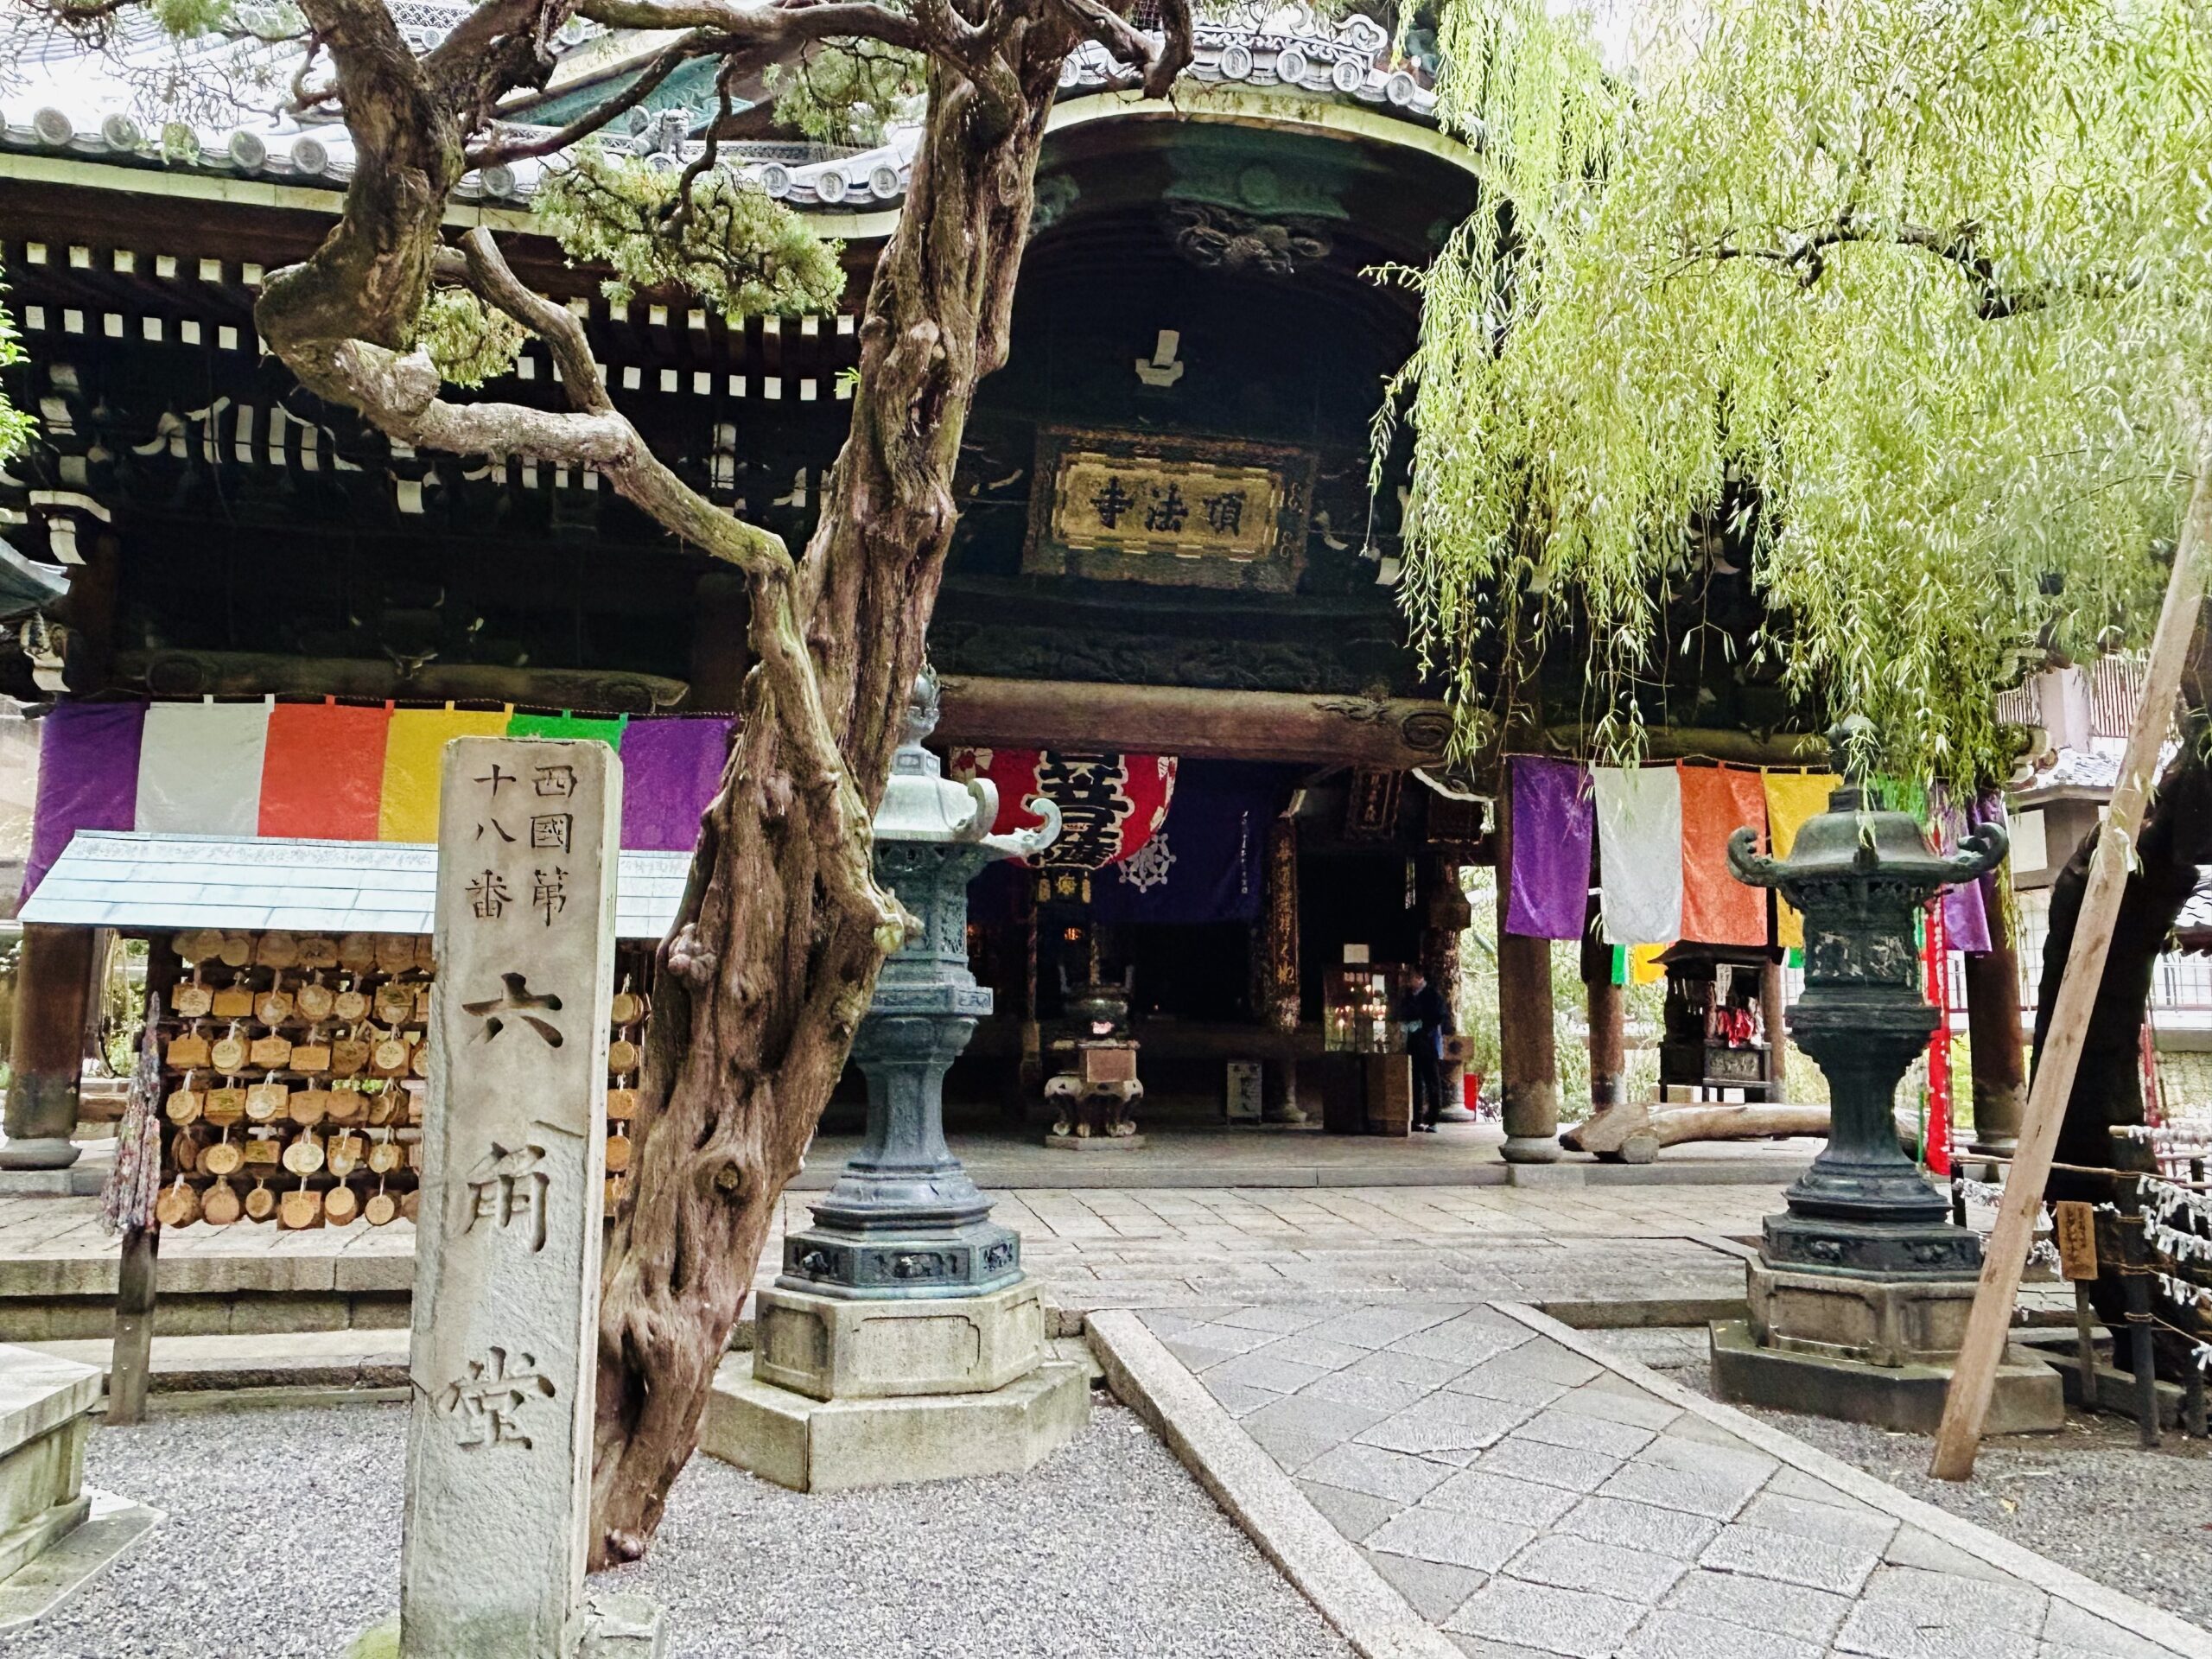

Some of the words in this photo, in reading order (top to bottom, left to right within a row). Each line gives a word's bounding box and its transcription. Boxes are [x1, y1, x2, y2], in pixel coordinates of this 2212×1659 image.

[1090, 475, 1247, 537] 頂法寺
[465, 763, 518, 919] 十八番
[437, 971, 564, 1452] 六角堂
